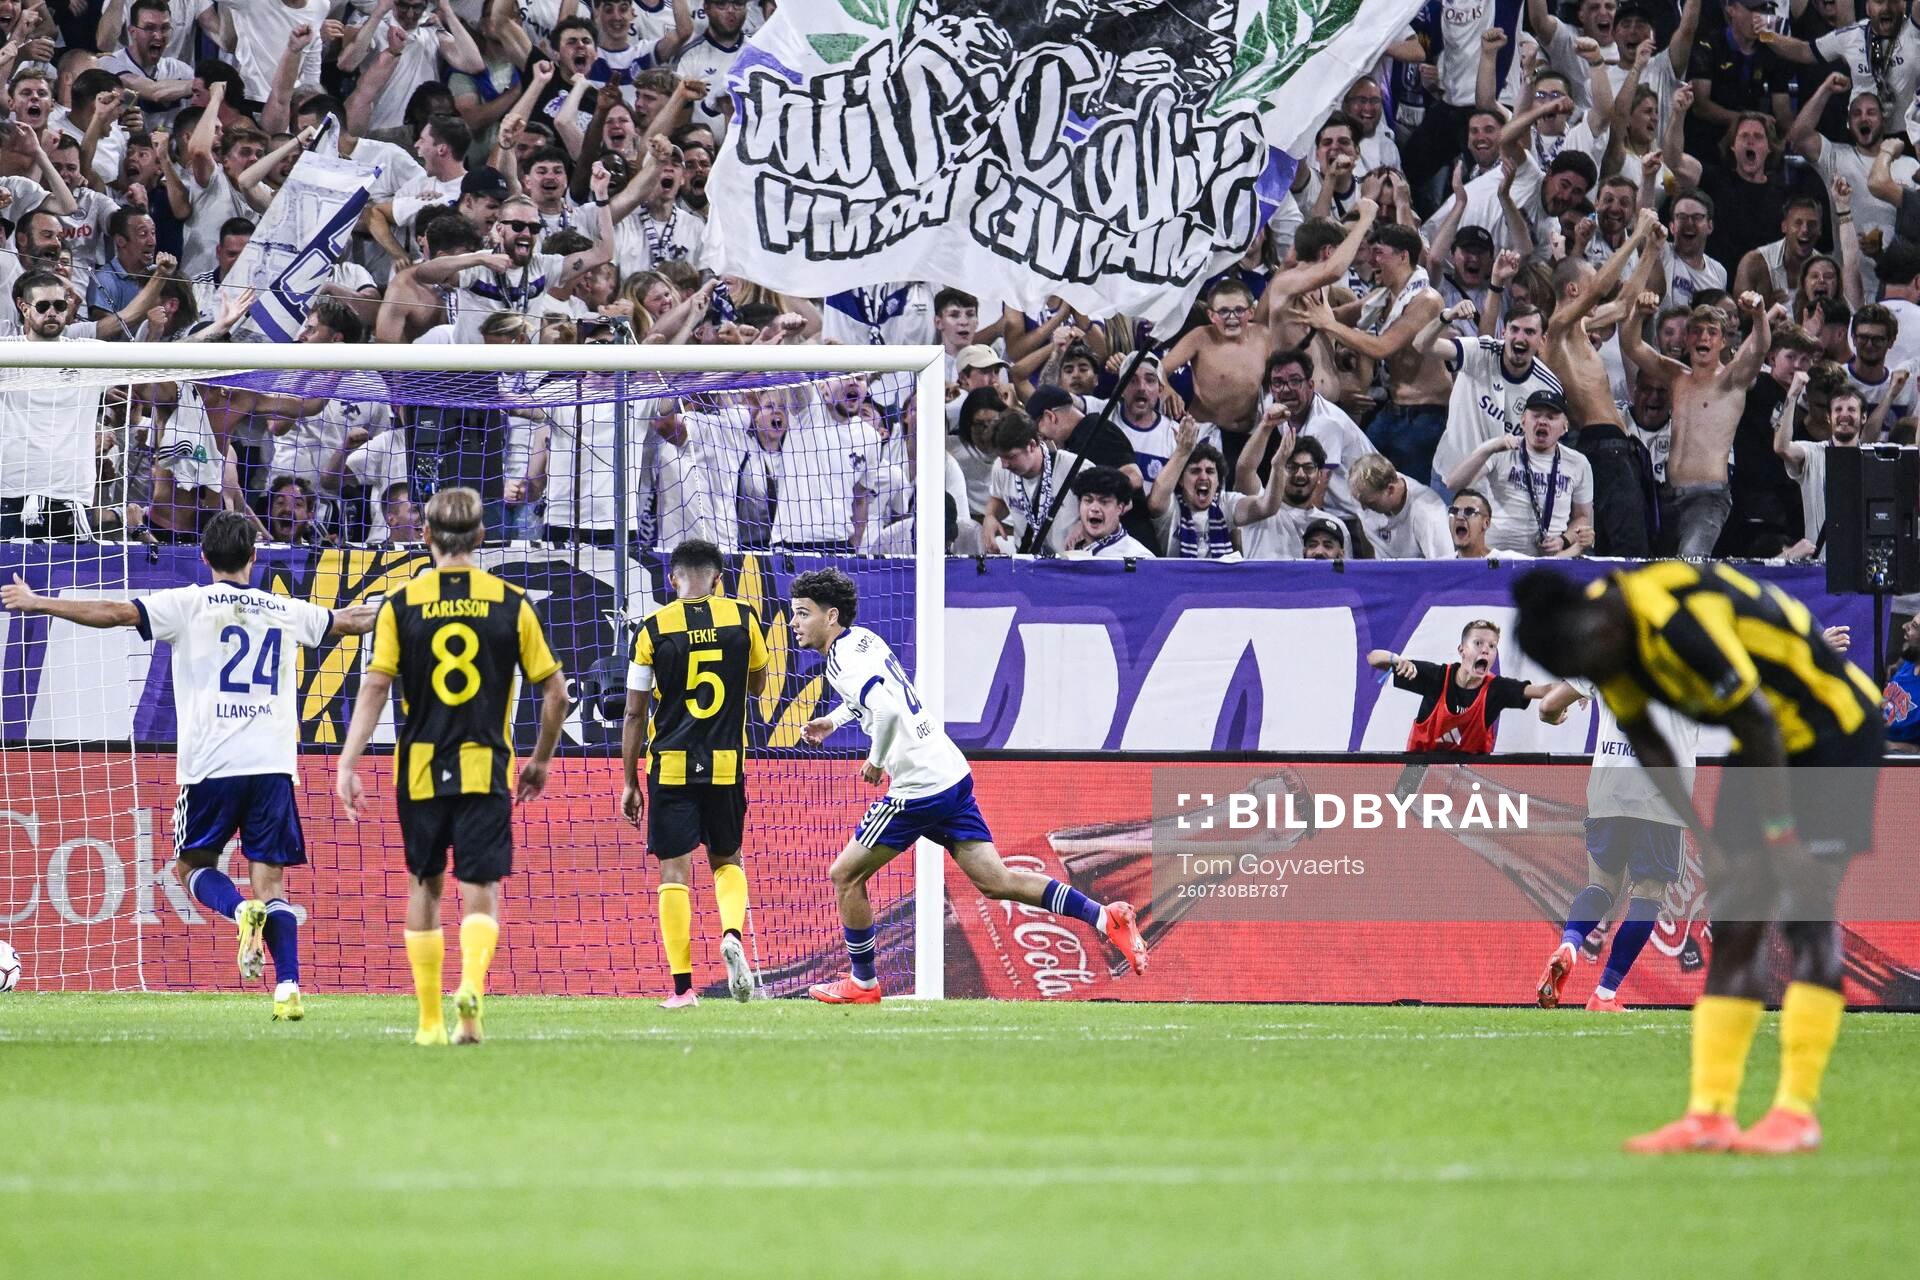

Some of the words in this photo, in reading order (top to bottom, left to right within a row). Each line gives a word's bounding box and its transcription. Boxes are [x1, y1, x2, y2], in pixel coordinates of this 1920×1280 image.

[207, 593, 287, 612] NAPOLEON
[422, 600, 490, 619] KARLSSON
[687, 628, 718, 645] TEKIE
[219, 625, 282, 696] 24
[431, 622, 481, 706] 8
[685, 649, 725, 719] 5
